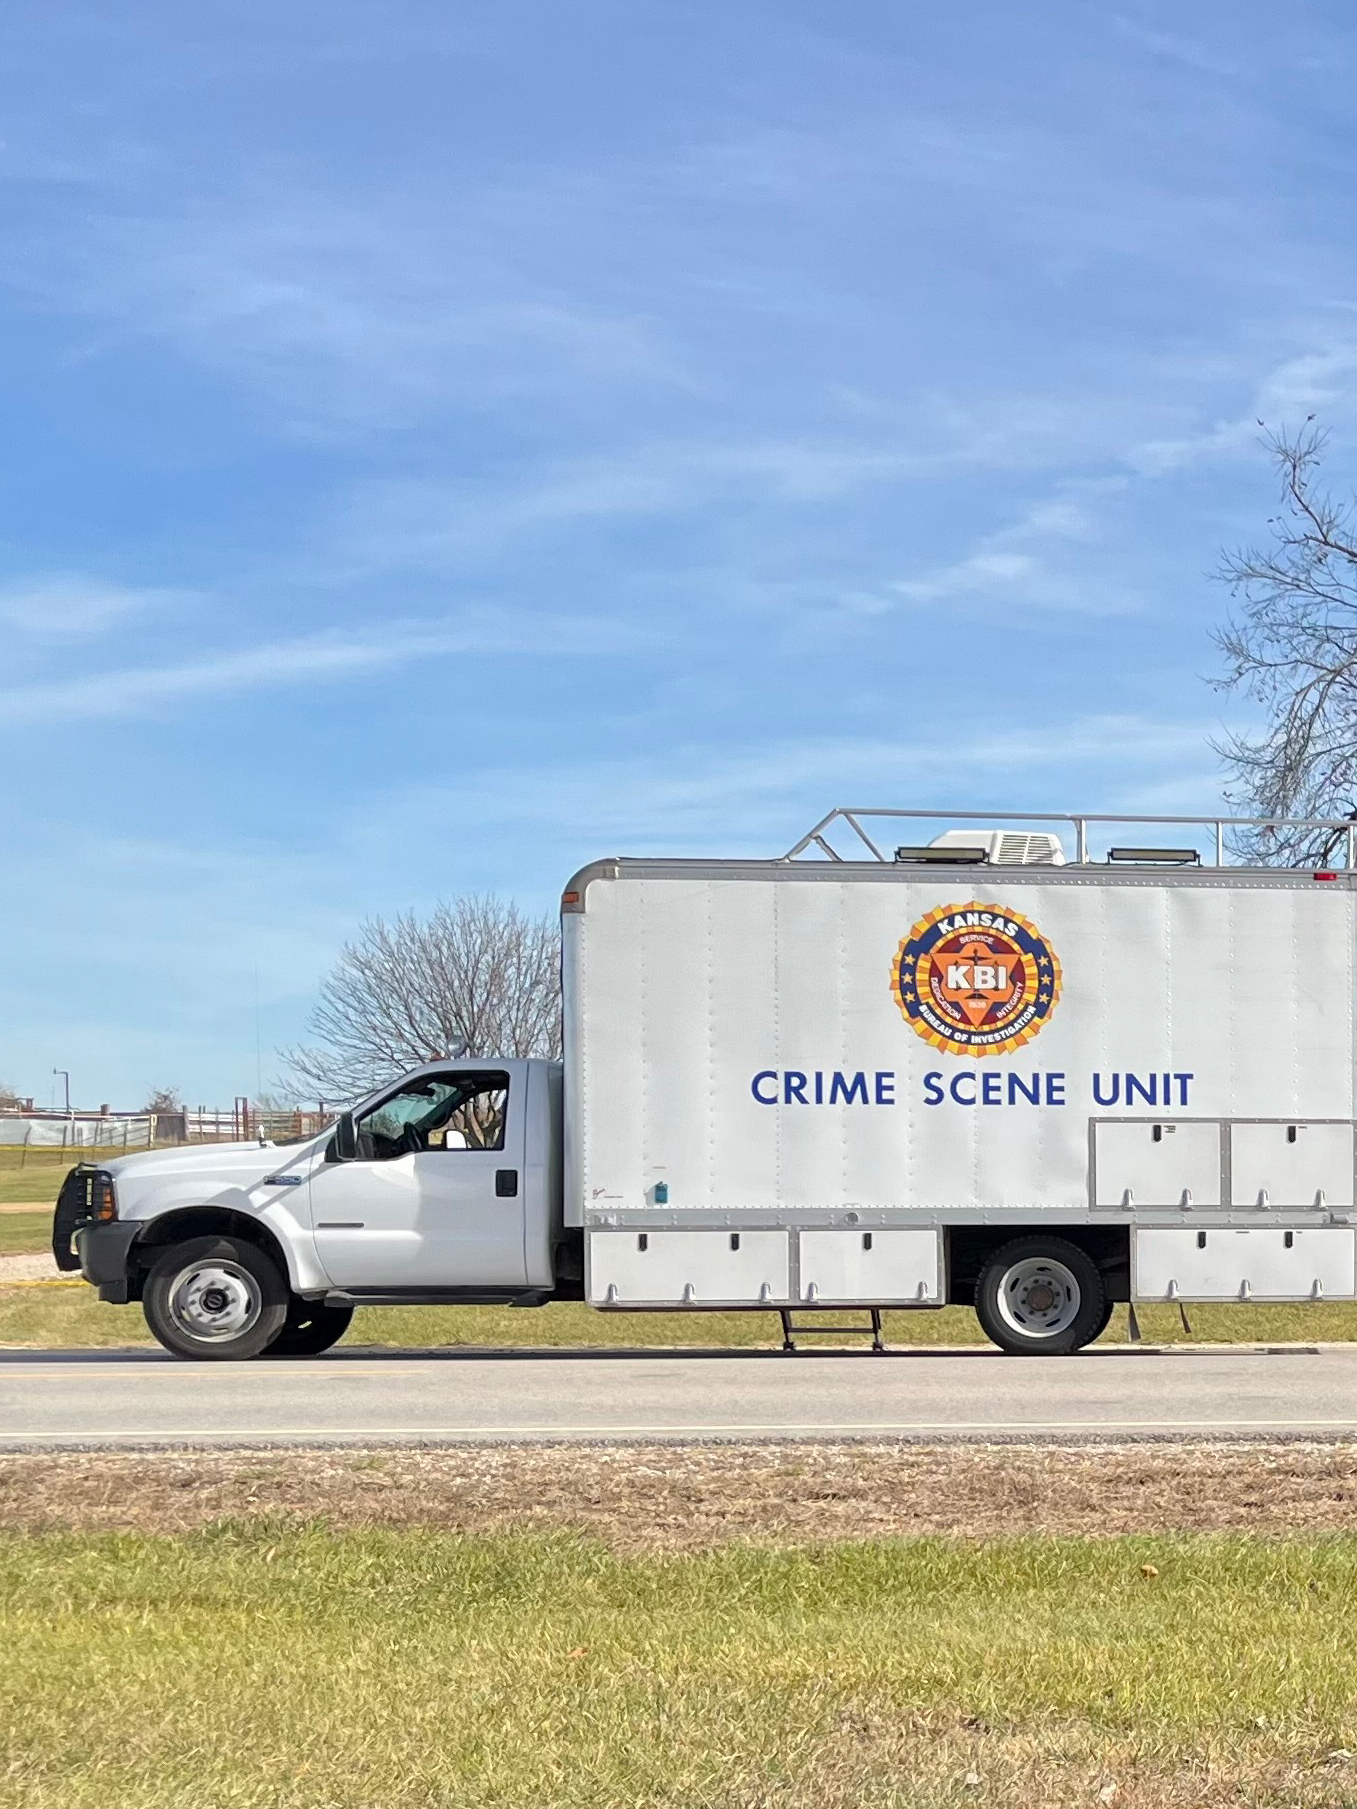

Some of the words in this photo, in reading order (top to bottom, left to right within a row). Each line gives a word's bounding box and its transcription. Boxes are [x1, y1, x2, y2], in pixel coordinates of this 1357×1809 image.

[937, 912, 1019, 937] KANSAS
[959, 934, 995, 945] SERVICE
[947, 965, 1007, 990] KBI
[930, 977, 962, 1020] DEDICATION
[996, 981, 1024, 1019] INTEGRITY
[918, 1004, 952, 1036] BUREAU
[953, 1032, 969, 1042] OF
[970, 1005, 1037, 1044] INVESTIGATION
[751, 1070, 895, 1106] CRIME
[923, 1071, 1066, 1106] SCENE
[1092, 1072, 1195, 1106] UNIT
